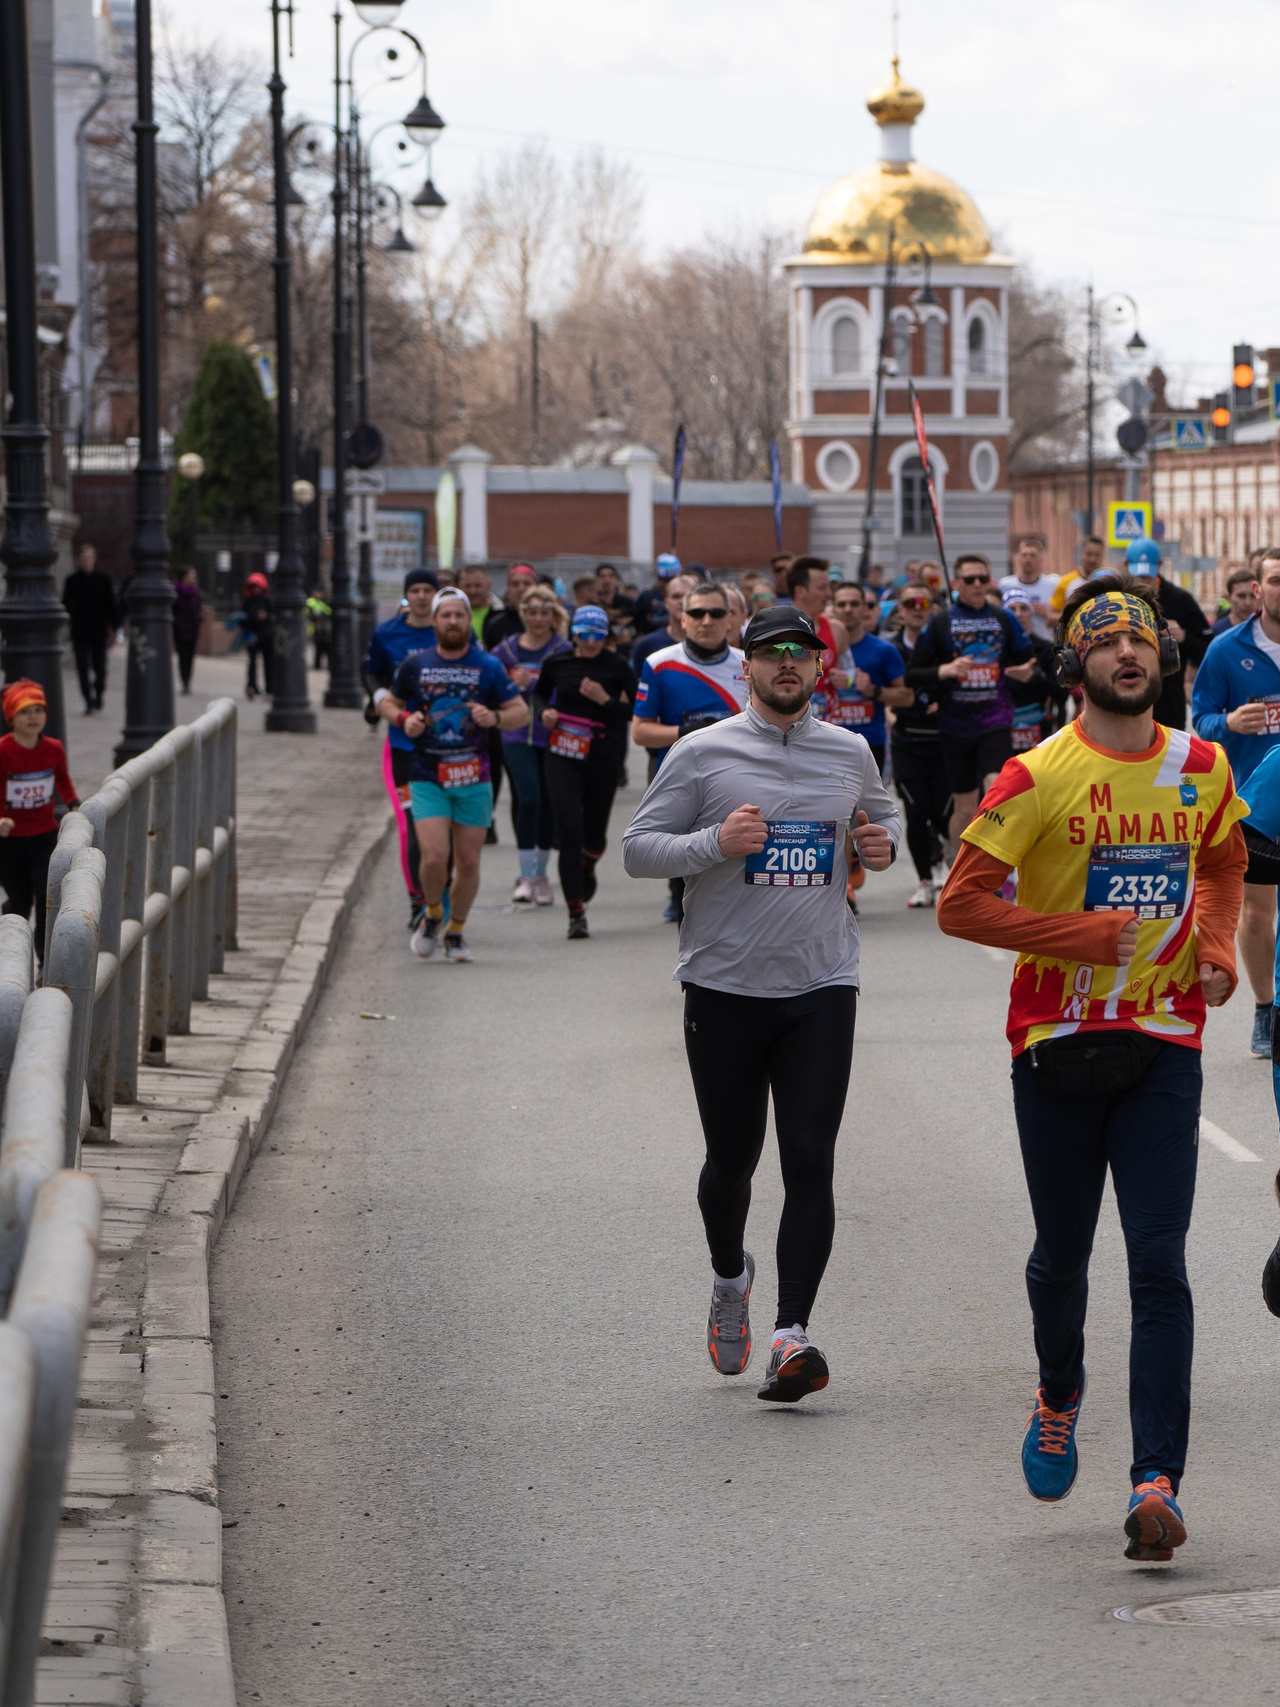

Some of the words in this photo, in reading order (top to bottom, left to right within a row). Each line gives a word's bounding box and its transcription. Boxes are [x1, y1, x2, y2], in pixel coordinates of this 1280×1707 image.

[23, 785, 45, 800] 232
[1068, 811, 1204, 845] SAMARA
[765, 847, 817, 871] 2106
[1107, 874, 1169, 903] 2332
